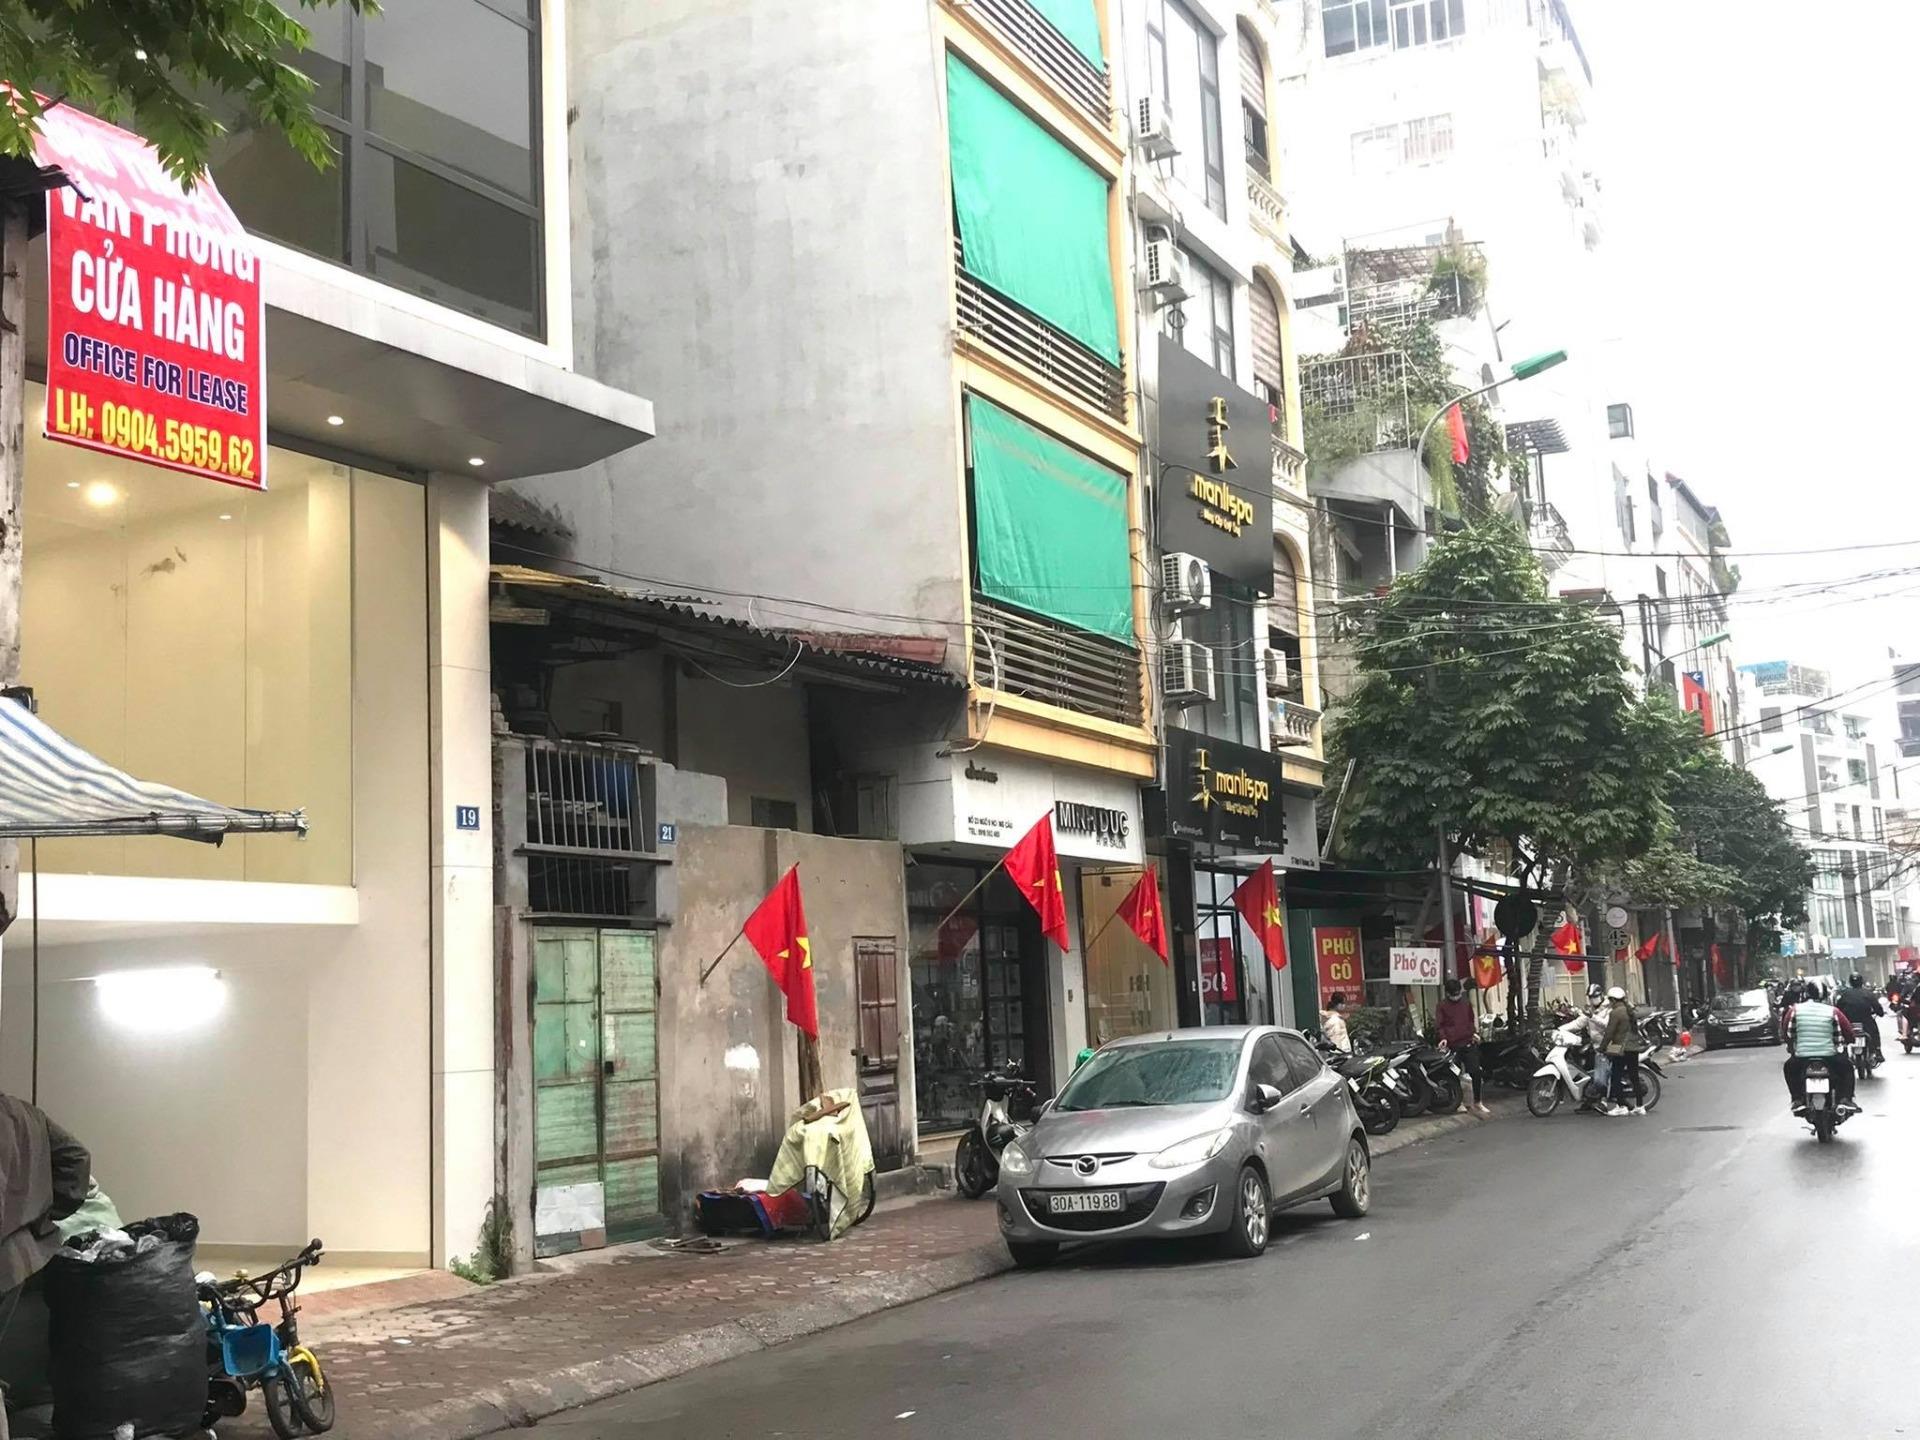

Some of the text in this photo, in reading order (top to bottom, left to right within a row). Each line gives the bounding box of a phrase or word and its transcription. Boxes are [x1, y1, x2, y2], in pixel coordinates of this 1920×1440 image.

[71, 239, 245, 362] CỬA HÀNG
[64, 332, 248, 414] OFFICE FOR LEASE
[55, 387, 255, 479] LH: 0904.5959.62
[461, 808, 476, 826] 19
[661, 825, 673, 840] 21
[1331, 957, 1352, 980] CỒ
[1393, 952, 1417, 970] Phở
[1420, 959, 1438, 977] Cồ
